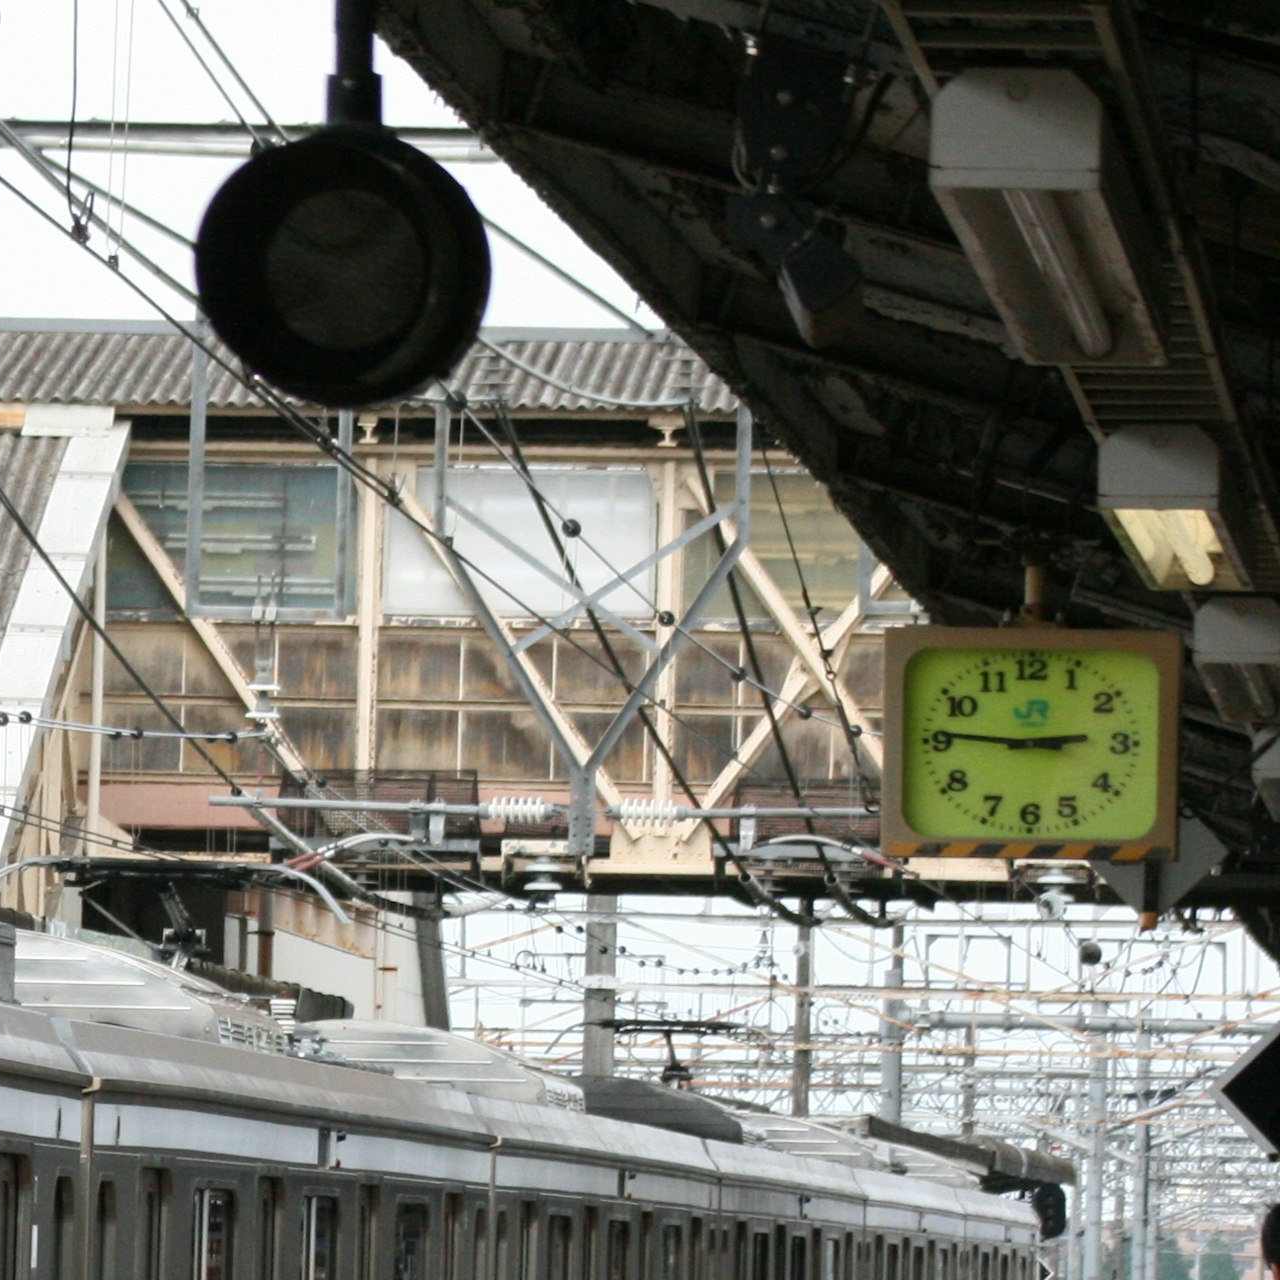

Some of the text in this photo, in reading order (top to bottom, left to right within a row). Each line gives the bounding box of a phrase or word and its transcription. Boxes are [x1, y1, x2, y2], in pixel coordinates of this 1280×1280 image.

[1015, 659, 1048, 682] 12
[1064, 668, 1078, 691] 1
[979, 671, 1008, 693] 11
[946, 695, 978, 718] 10
[1013, 699, 1050, 720] JR
[1093, 692, 1114, 714] 2
[931, 730, 953, 752] 9
[1110, 732, 1131, 754] 3
[946, 770, 968, 792] 8
[1092, 772, 1112, 793] 4
[983, 795, 1003, 817] 7
[1020, 803, 1041, 825] 6
[1057, 796, 1078, 818] 5
